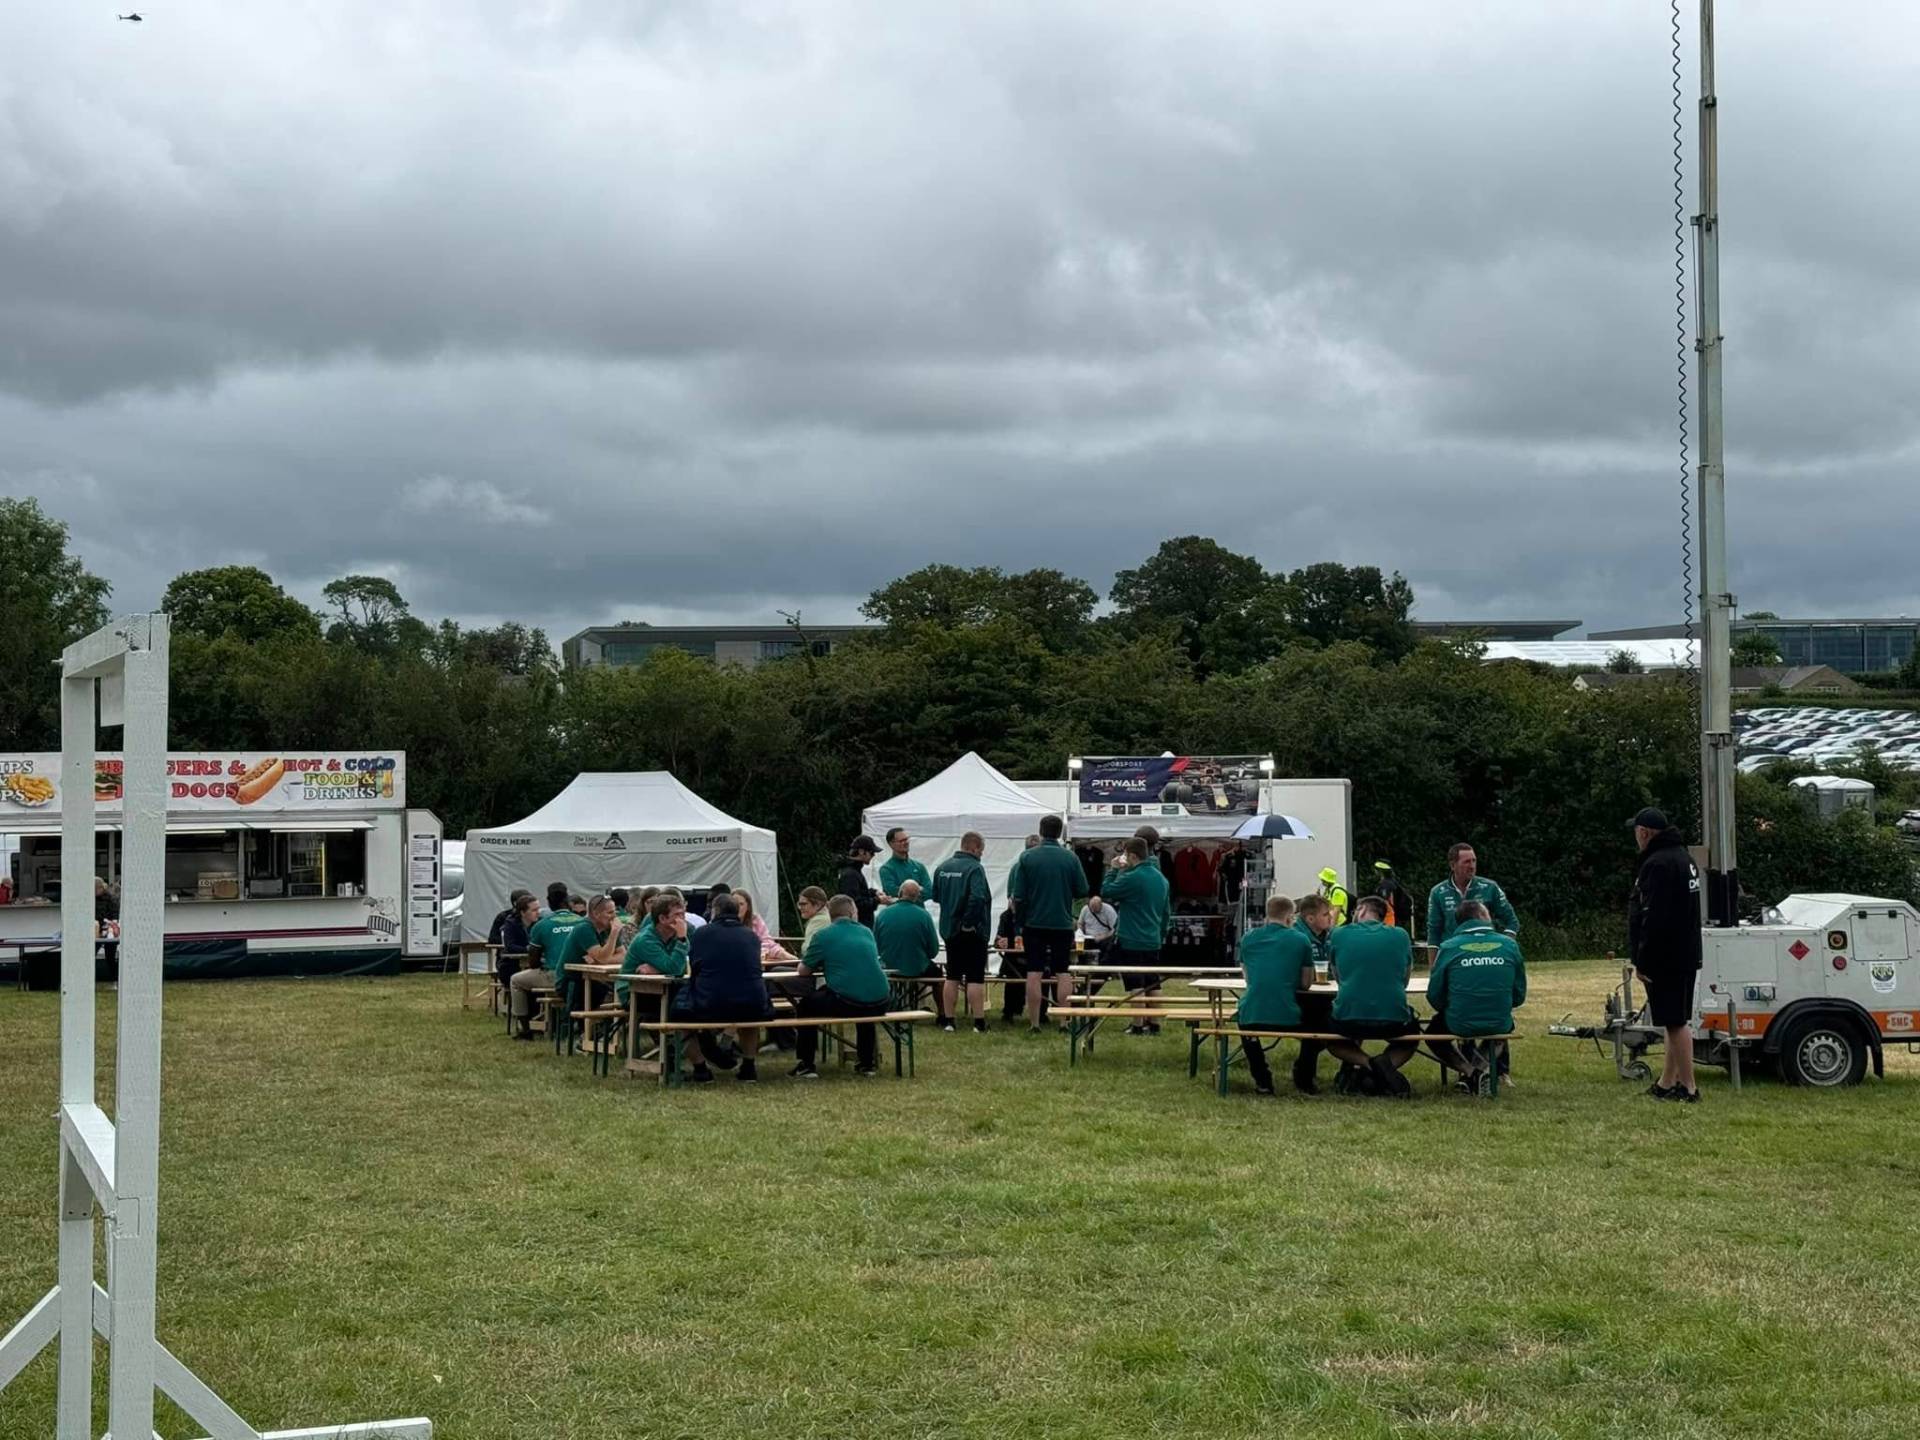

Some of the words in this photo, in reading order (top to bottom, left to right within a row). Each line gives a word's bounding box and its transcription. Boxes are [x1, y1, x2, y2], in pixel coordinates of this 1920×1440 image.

[0, 760, 33, 775] IPS
[228, 760, 246, 776] &
[283, 759, 322, 772] HOT
[326, 759, 341, 772] &
[304, 773, 359, 786] FOOD
[1091, 779, 1147, 788] PITWALK
[171, 782, 240, 798] DOGS
[304, 786, 377, 800] DRINKS
[480, 837, 508, 845] ORDER
[510, 838, 532, 846] HERE
[666, 837, 704, 845] COLLECT
[705, 835, 728, 844] HERE
[552, 926, 575, 935] aram
[1460, 956, 1505, 967] aramco
